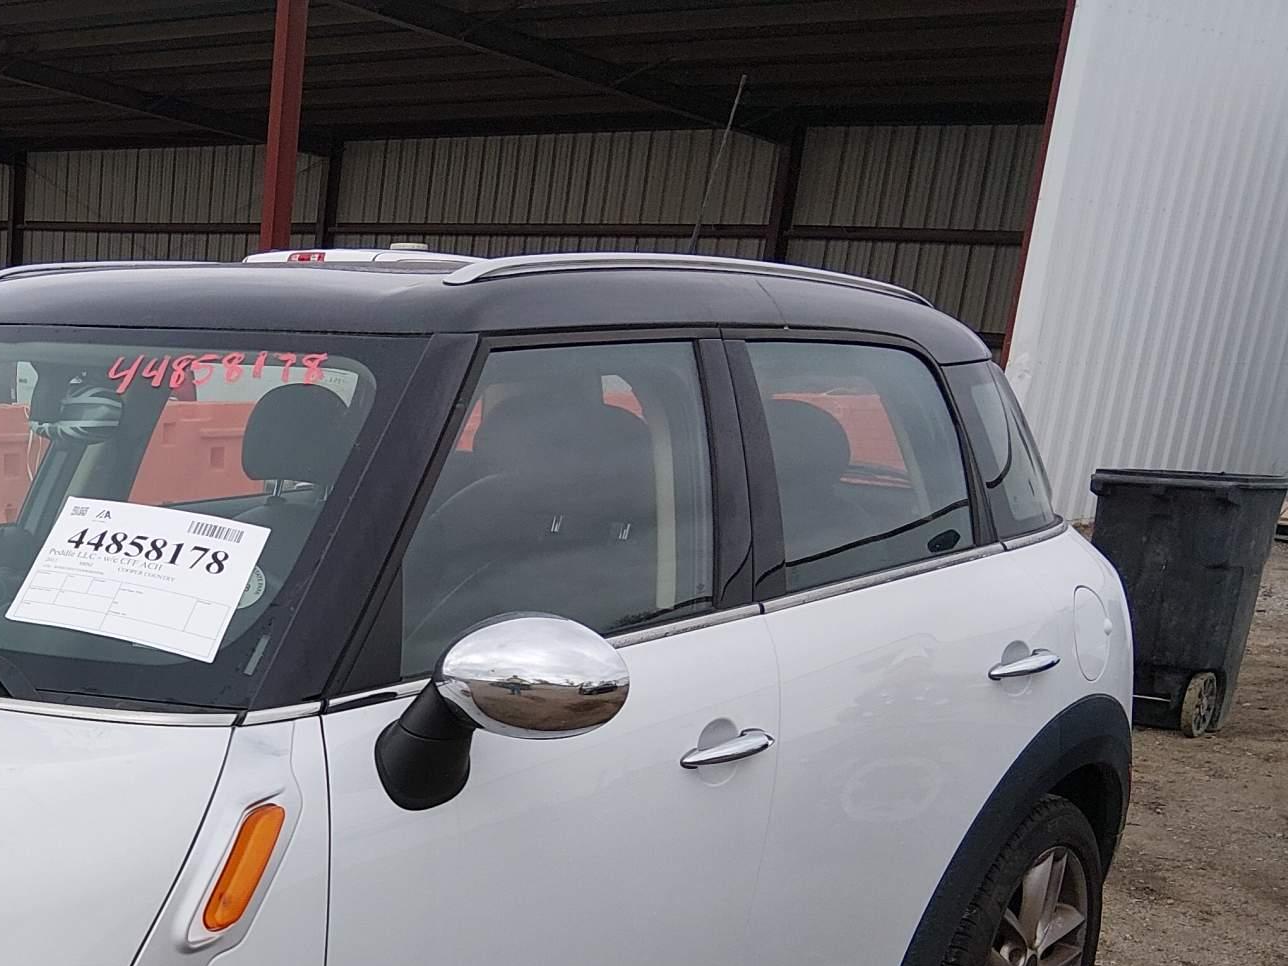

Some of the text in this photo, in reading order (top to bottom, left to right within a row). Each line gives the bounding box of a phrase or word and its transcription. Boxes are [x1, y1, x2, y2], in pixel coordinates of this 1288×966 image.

[108, 351, 328, 394] 44858178
[67, 527, 230, 576] 44858178
[77, 551, 97, 560] LLC
[140, 560, 165, 571] ACH
